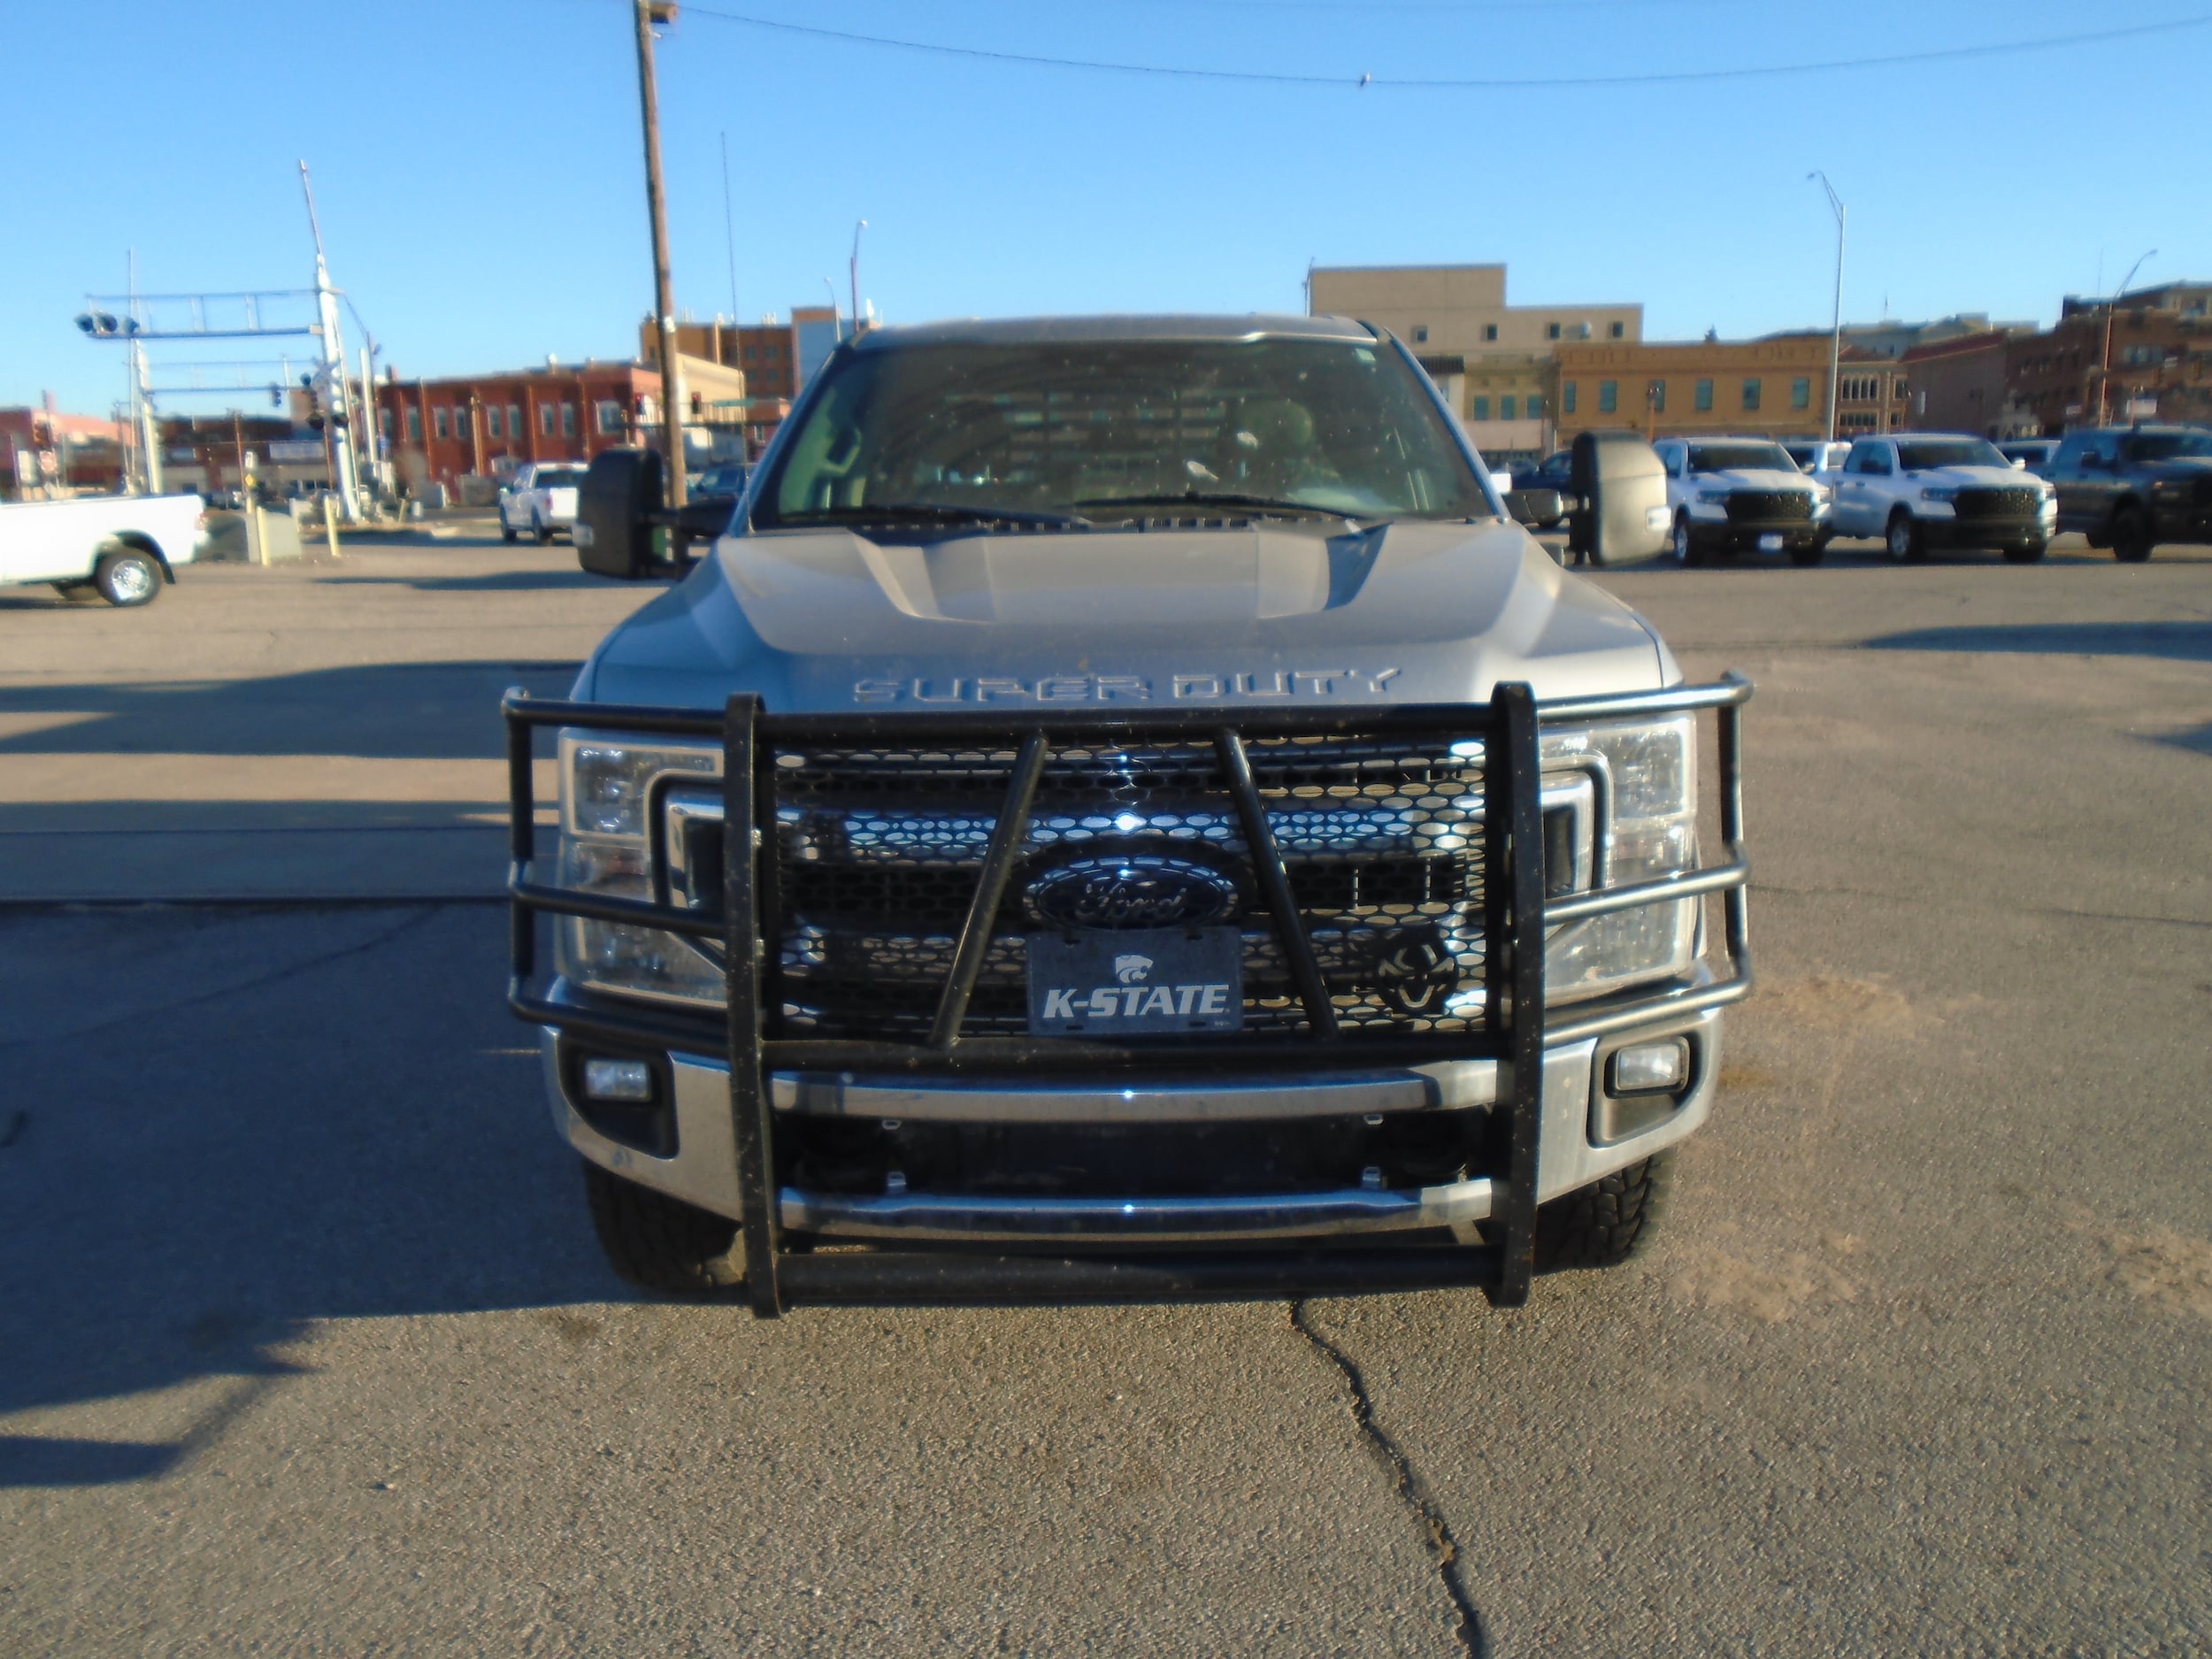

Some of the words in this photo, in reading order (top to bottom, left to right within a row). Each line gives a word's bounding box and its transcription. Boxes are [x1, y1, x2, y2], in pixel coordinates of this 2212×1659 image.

[853, 671, 1149, 703] SUPER
[1173, 667, 1402, 698] DUTY
[1075, 882, 1187, 921] Ford
[1043, 984, 1230, 1018] K-STATE
